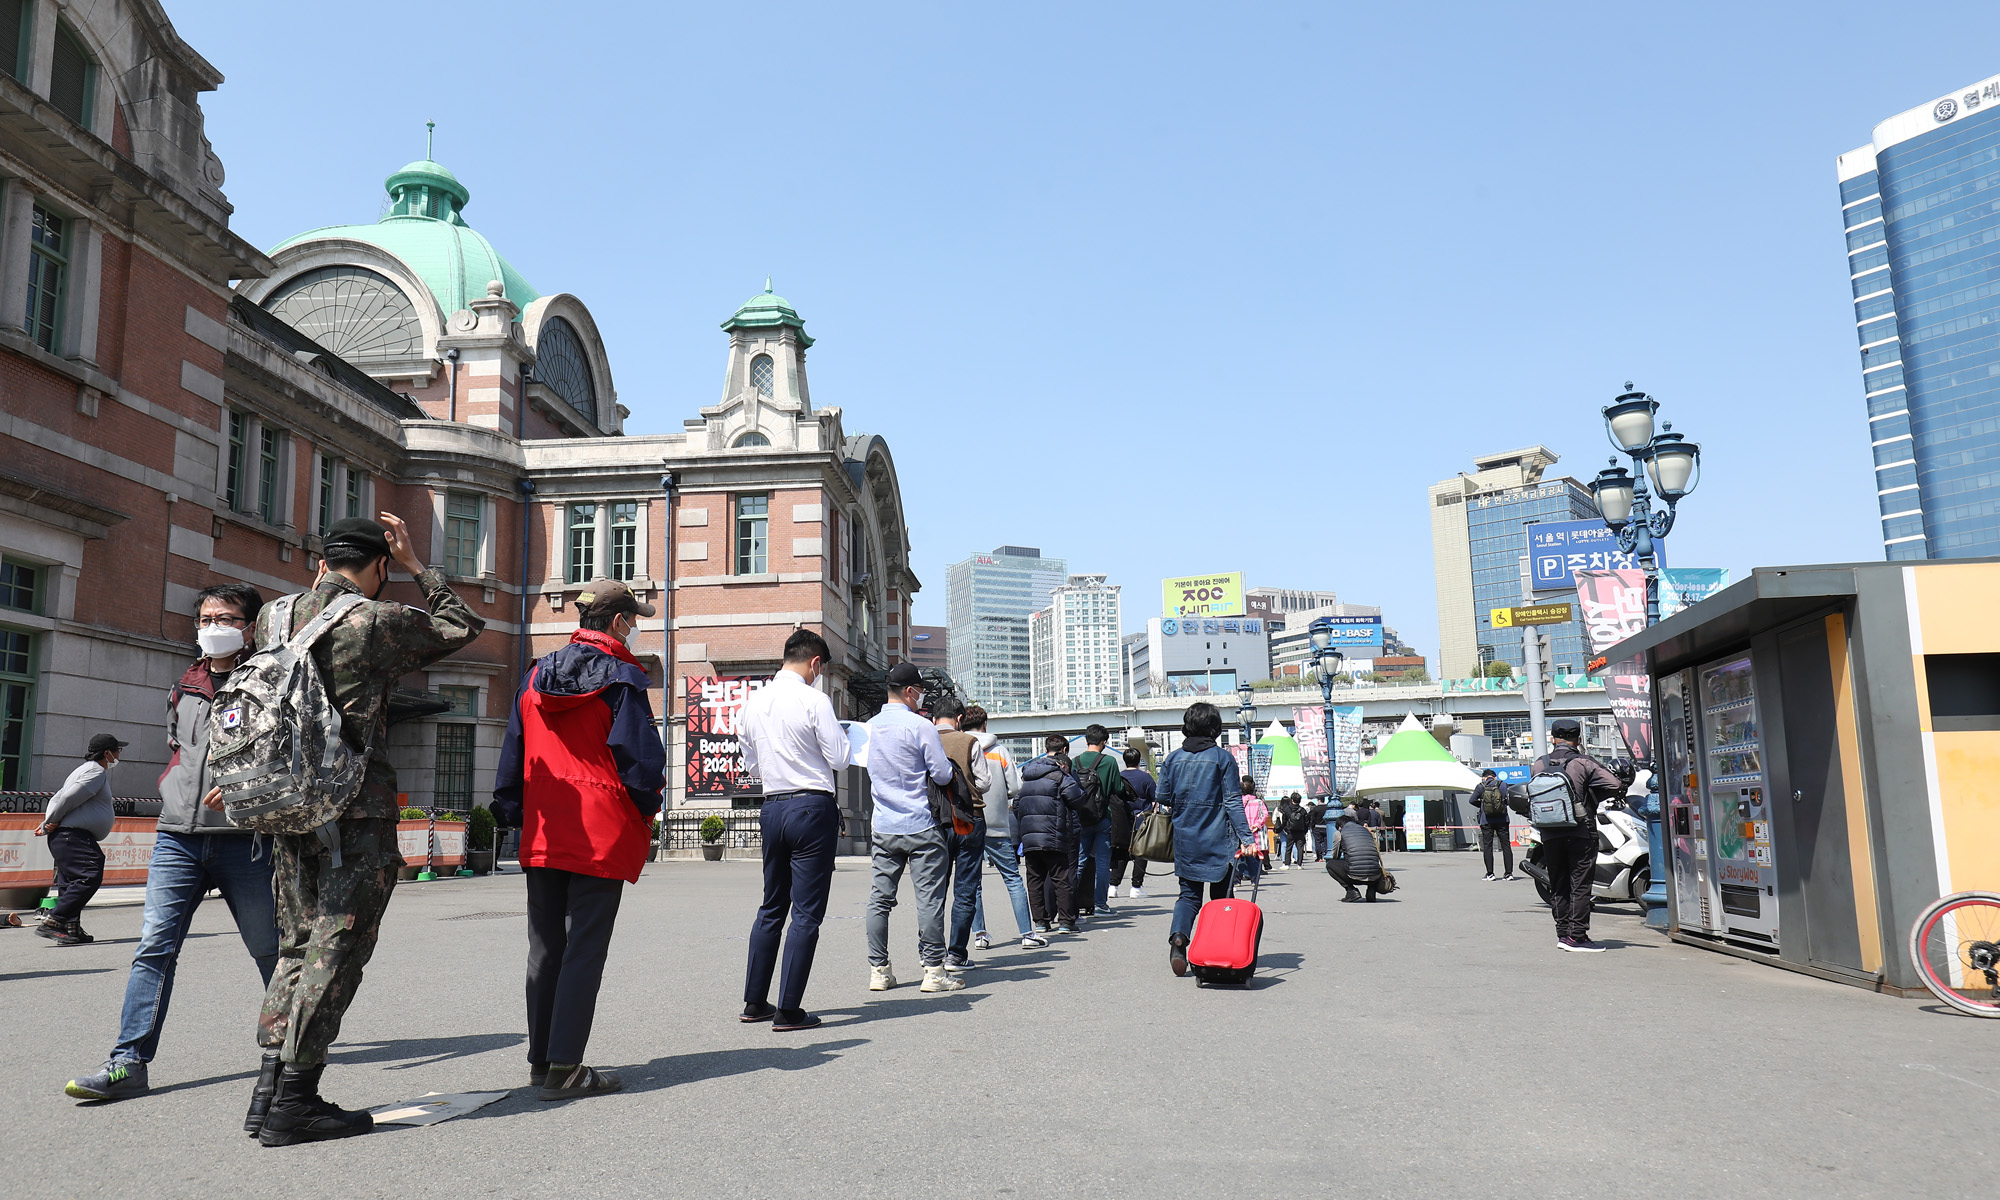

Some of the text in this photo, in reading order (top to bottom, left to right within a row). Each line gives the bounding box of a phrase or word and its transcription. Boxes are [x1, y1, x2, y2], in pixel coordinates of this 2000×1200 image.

[1963, 81, 2000, 109] 연세
[1478, 485, 1564, 508] HF 한국주택금융공사
[1534, 527, 1613, 543] 서울역 롯데아울렛
[976, 556, 993, 564] AIA
[1543, 550, 1635, 577] P 주차장
[1174, 577, 1231, 588] 기본이 좋아요 진에어
[1514, 606, 1568, 618] 장애인콜택시 승강장
[1182, 619, 1261, 635] 한진택배
[1346, 628, 1374, 638] BASF
[1726, 865, 1759, 884] StoryWay
